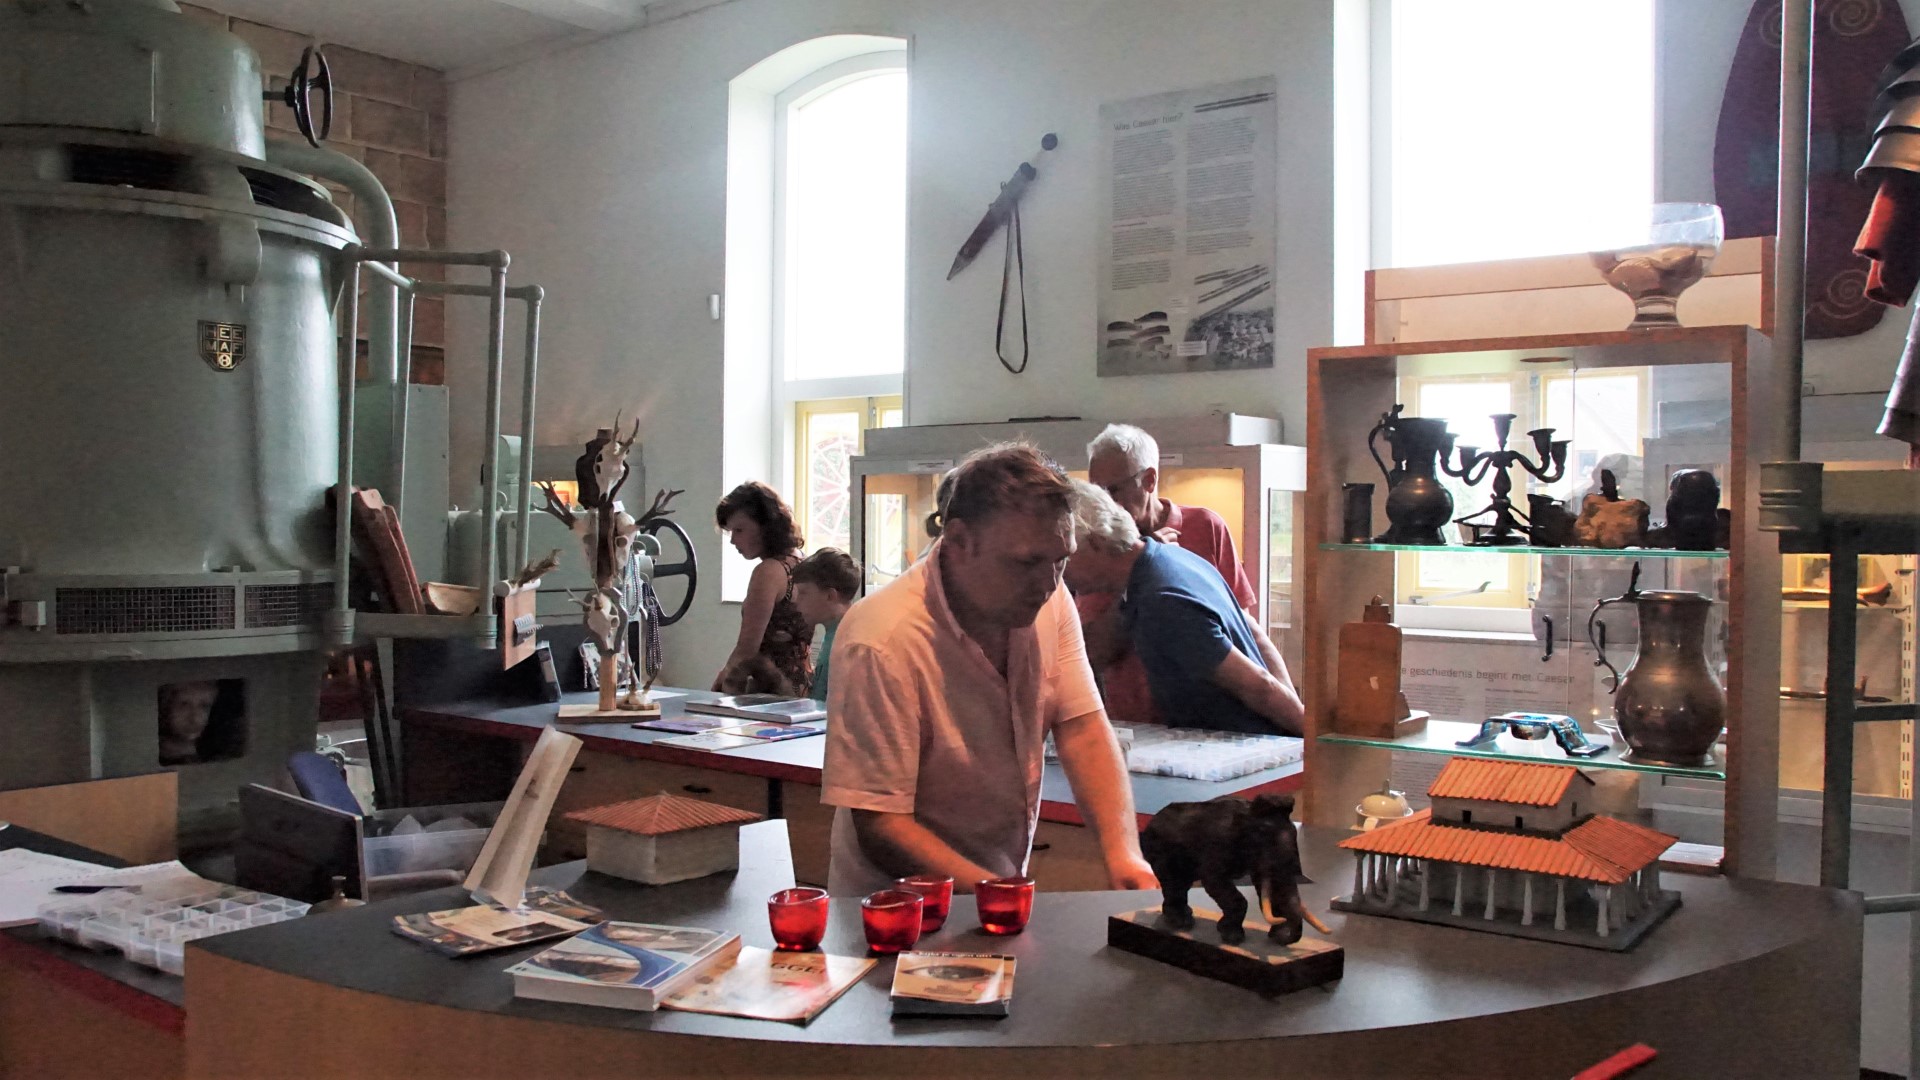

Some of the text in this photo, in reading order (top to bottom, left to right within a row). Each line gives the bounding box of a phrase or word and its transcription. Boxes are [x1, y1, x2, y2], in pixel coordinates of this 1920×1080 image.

[1410, 667, 1473, 678] geschiedenis
[1476, 671, 1507, 682] begint
[1511, 672, 1532, 682] met
[1537, 672, 1575, 684] Caesar
